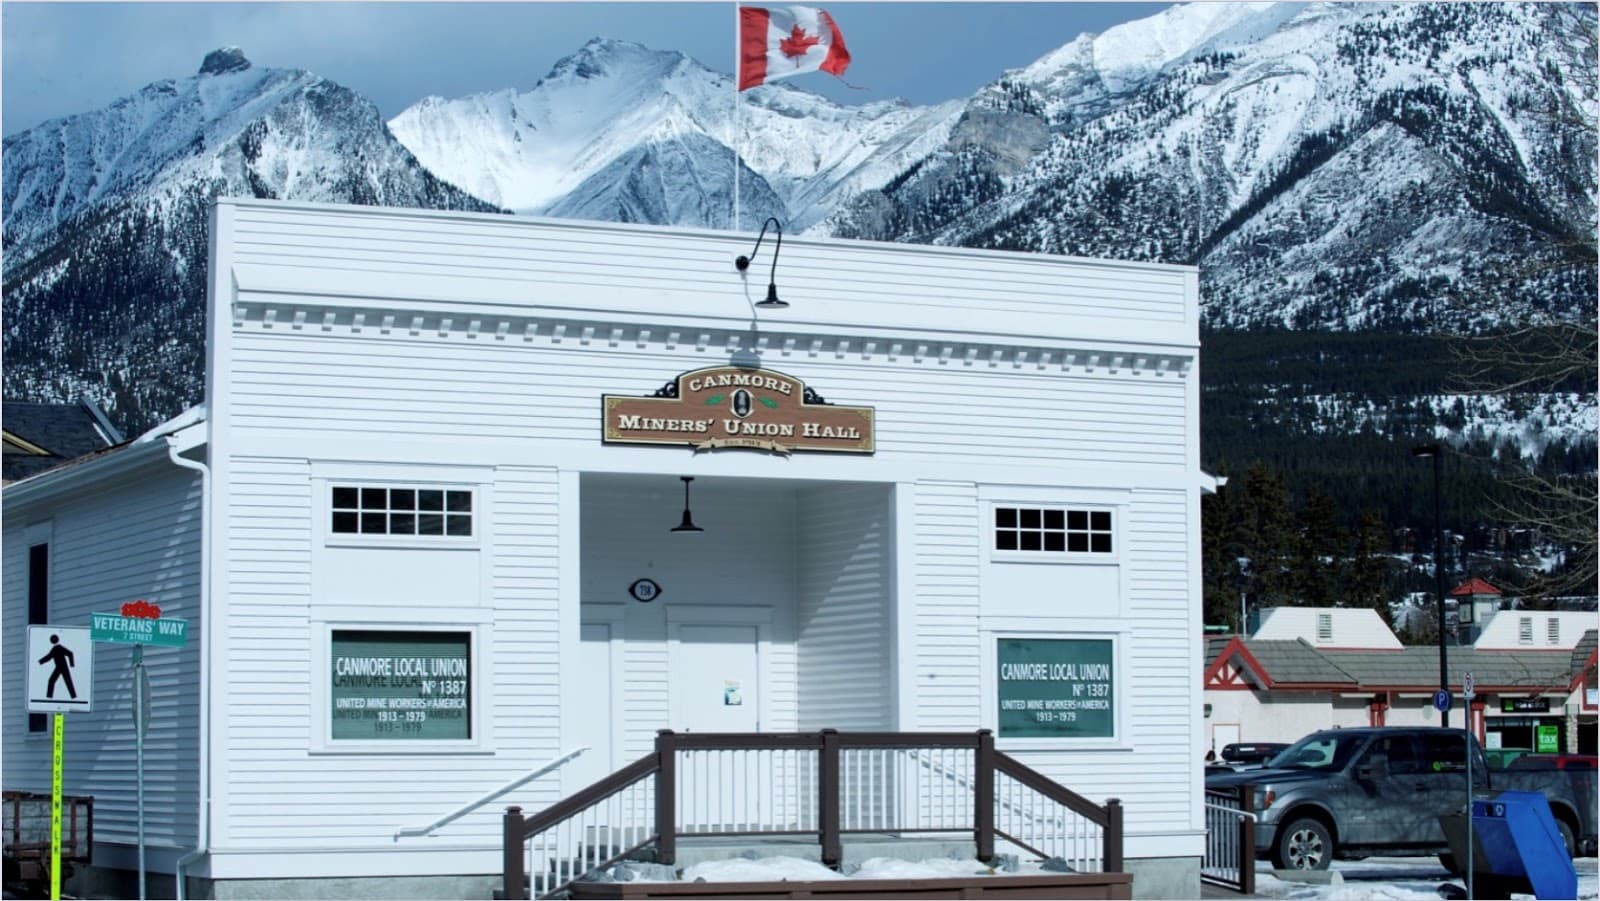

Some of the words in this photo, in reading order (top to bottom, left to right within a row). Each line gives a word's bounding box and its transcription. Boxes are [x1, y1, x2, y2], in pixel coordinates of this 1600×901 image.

[689, 373, 793, 396] CANMORE
[723, 418, 795, 437] UNION
[802, 422, 861, 440] HALL
[94, 616, 157, 634] VETERANS'
[159, 621, 185, 636] WAY
[129, 632, 153, 642] STREET
[336, 657, 391, 677] CANMORE
[394, 658, 428, 677] LOCAL
[431, 658, 467, 677] UNION
[1001, 663, 1048, 681] CANMORE
[1049, 664, 1078, 681] LOCAL
[1080, 664, 1110, 681] UNION
[439, 680, 467, 695] 1387
[1087, 684, 1110, 697] 1387
[336, 697, 365, 709] UNITED
[367, 698, 387, 709] MINE
[389, 698, 426, 709] WORKERS
[432, 698, 467, 709] AMERICA
[1001, 699, 1026, 710] UNITED
[1027, 700, 1044, 710] MINE
[1045, 700, 1076, 710] WORKERS
[1082, 700, 1110, 710] AMERICA
[1438, 692, 1446, 703] P
[1539, 735, 1556, 744] tax
[53, 725, 62, 855] CROSSWALK
